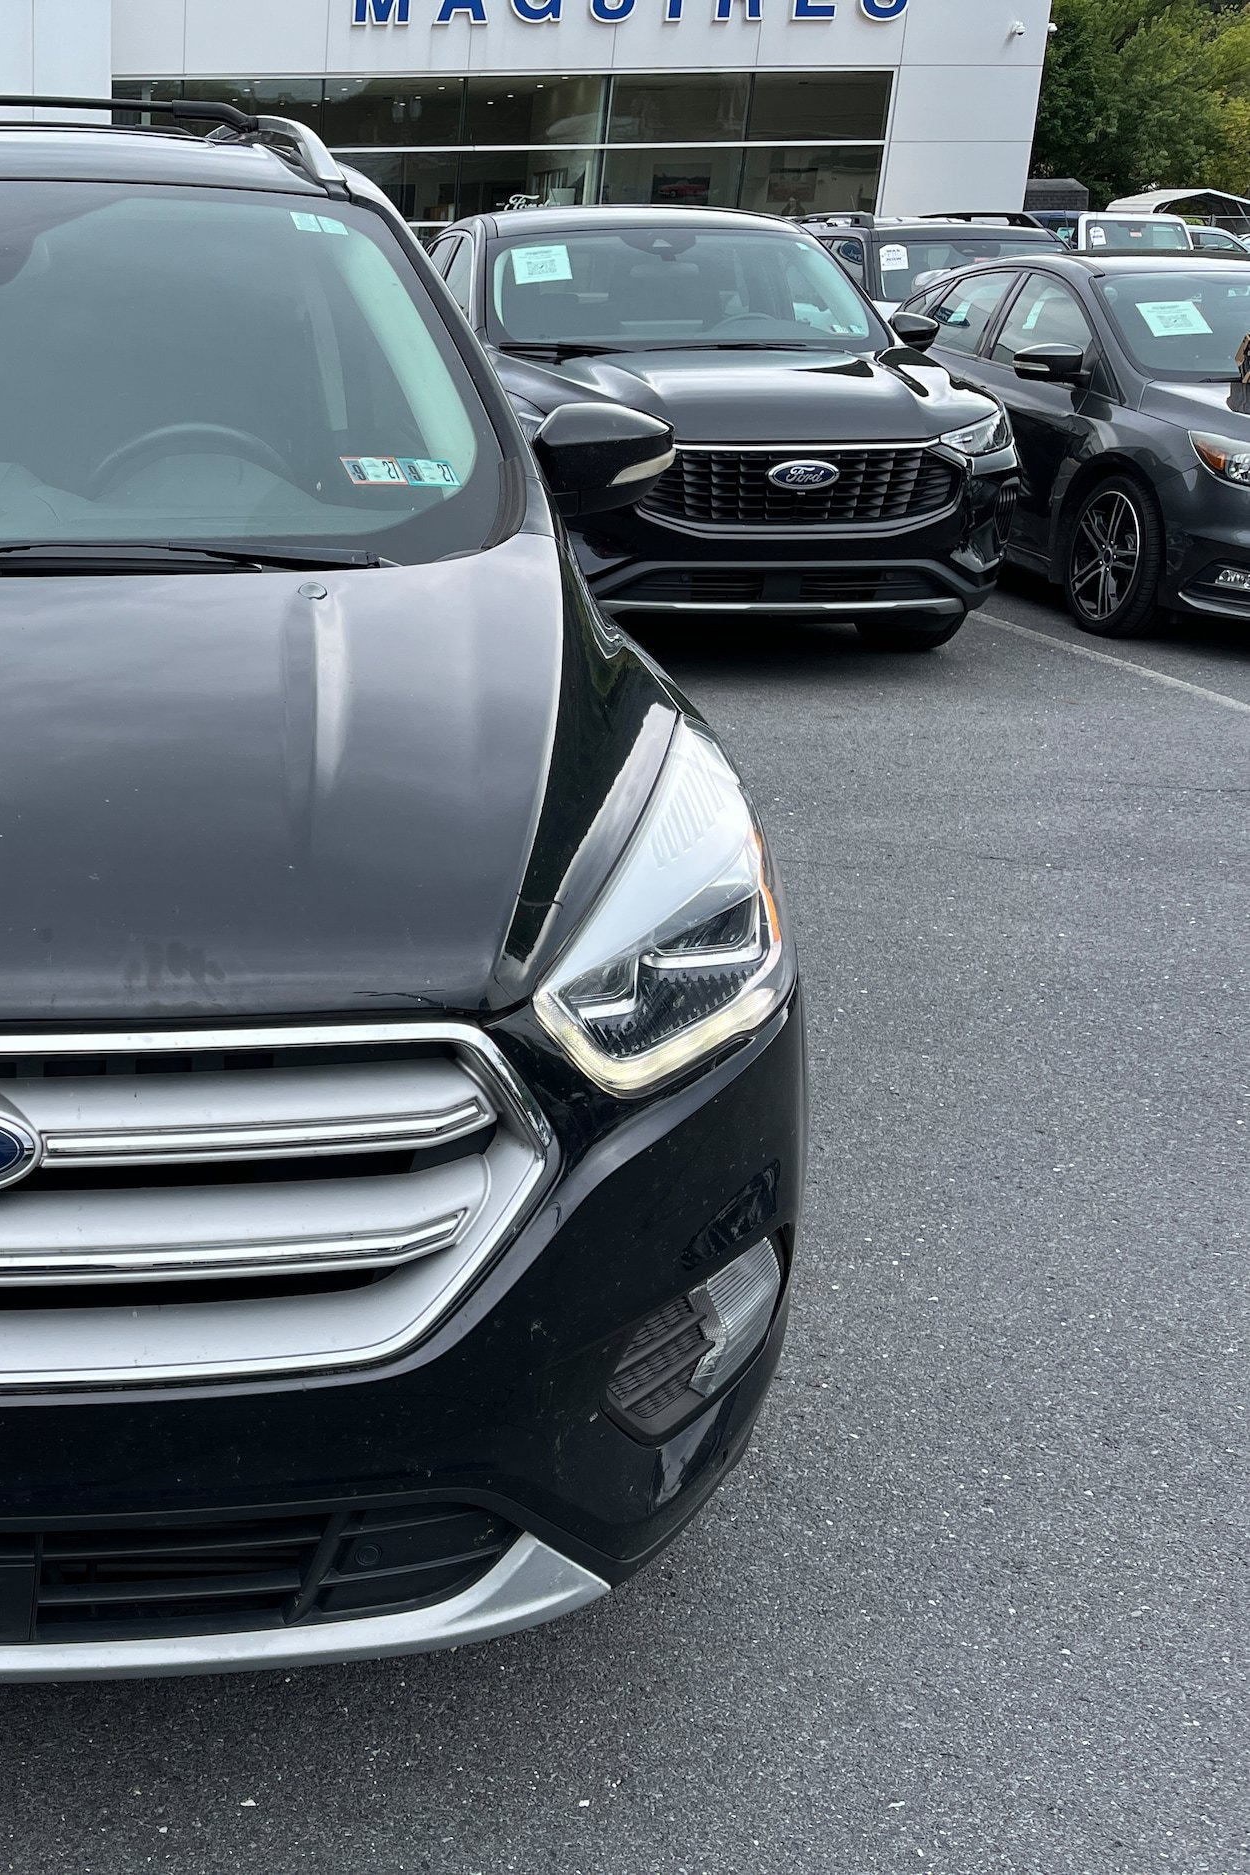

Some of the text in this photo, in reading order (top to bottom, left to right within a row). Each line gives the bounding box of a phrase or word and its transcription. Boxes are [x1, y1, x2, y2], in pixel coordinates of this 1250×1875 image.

[382, 461, 400, 481] 27
[436, 463, 455, 483] 27
[785, 466, 825, 483] Ford
